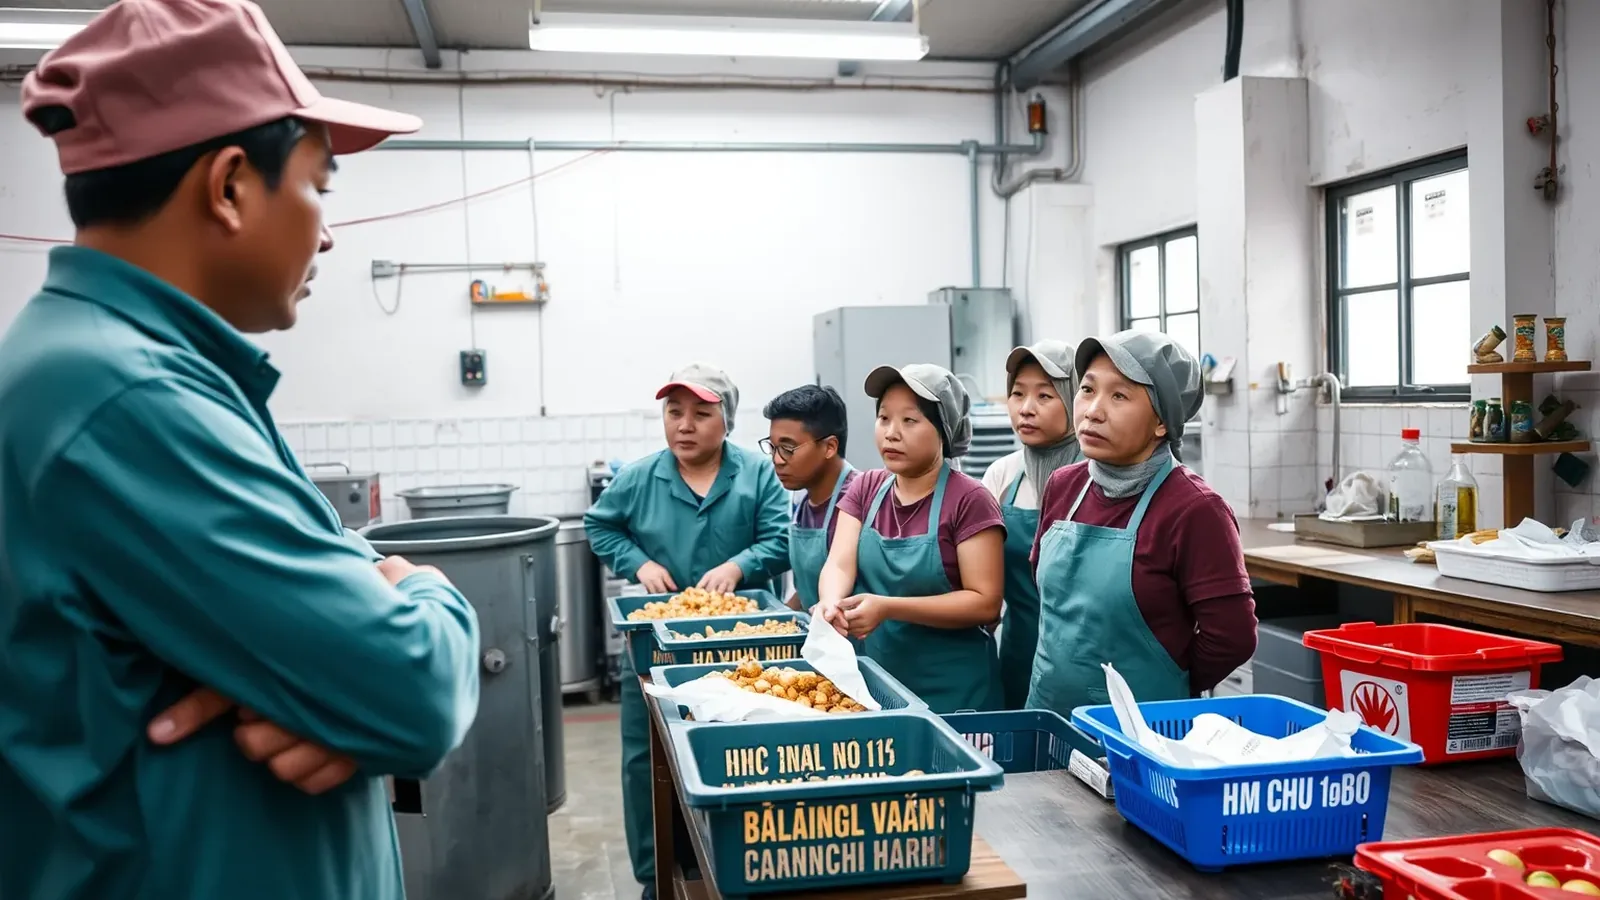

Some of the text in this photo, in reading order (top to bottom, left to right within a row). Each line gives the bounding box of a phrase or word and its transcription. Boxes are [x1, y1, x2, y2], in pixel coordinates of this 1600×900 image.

[833, 740, 860, 770] NO
[1223, 781, 1260, 816] HM
[1267, 778, 1313, 813] CHU
